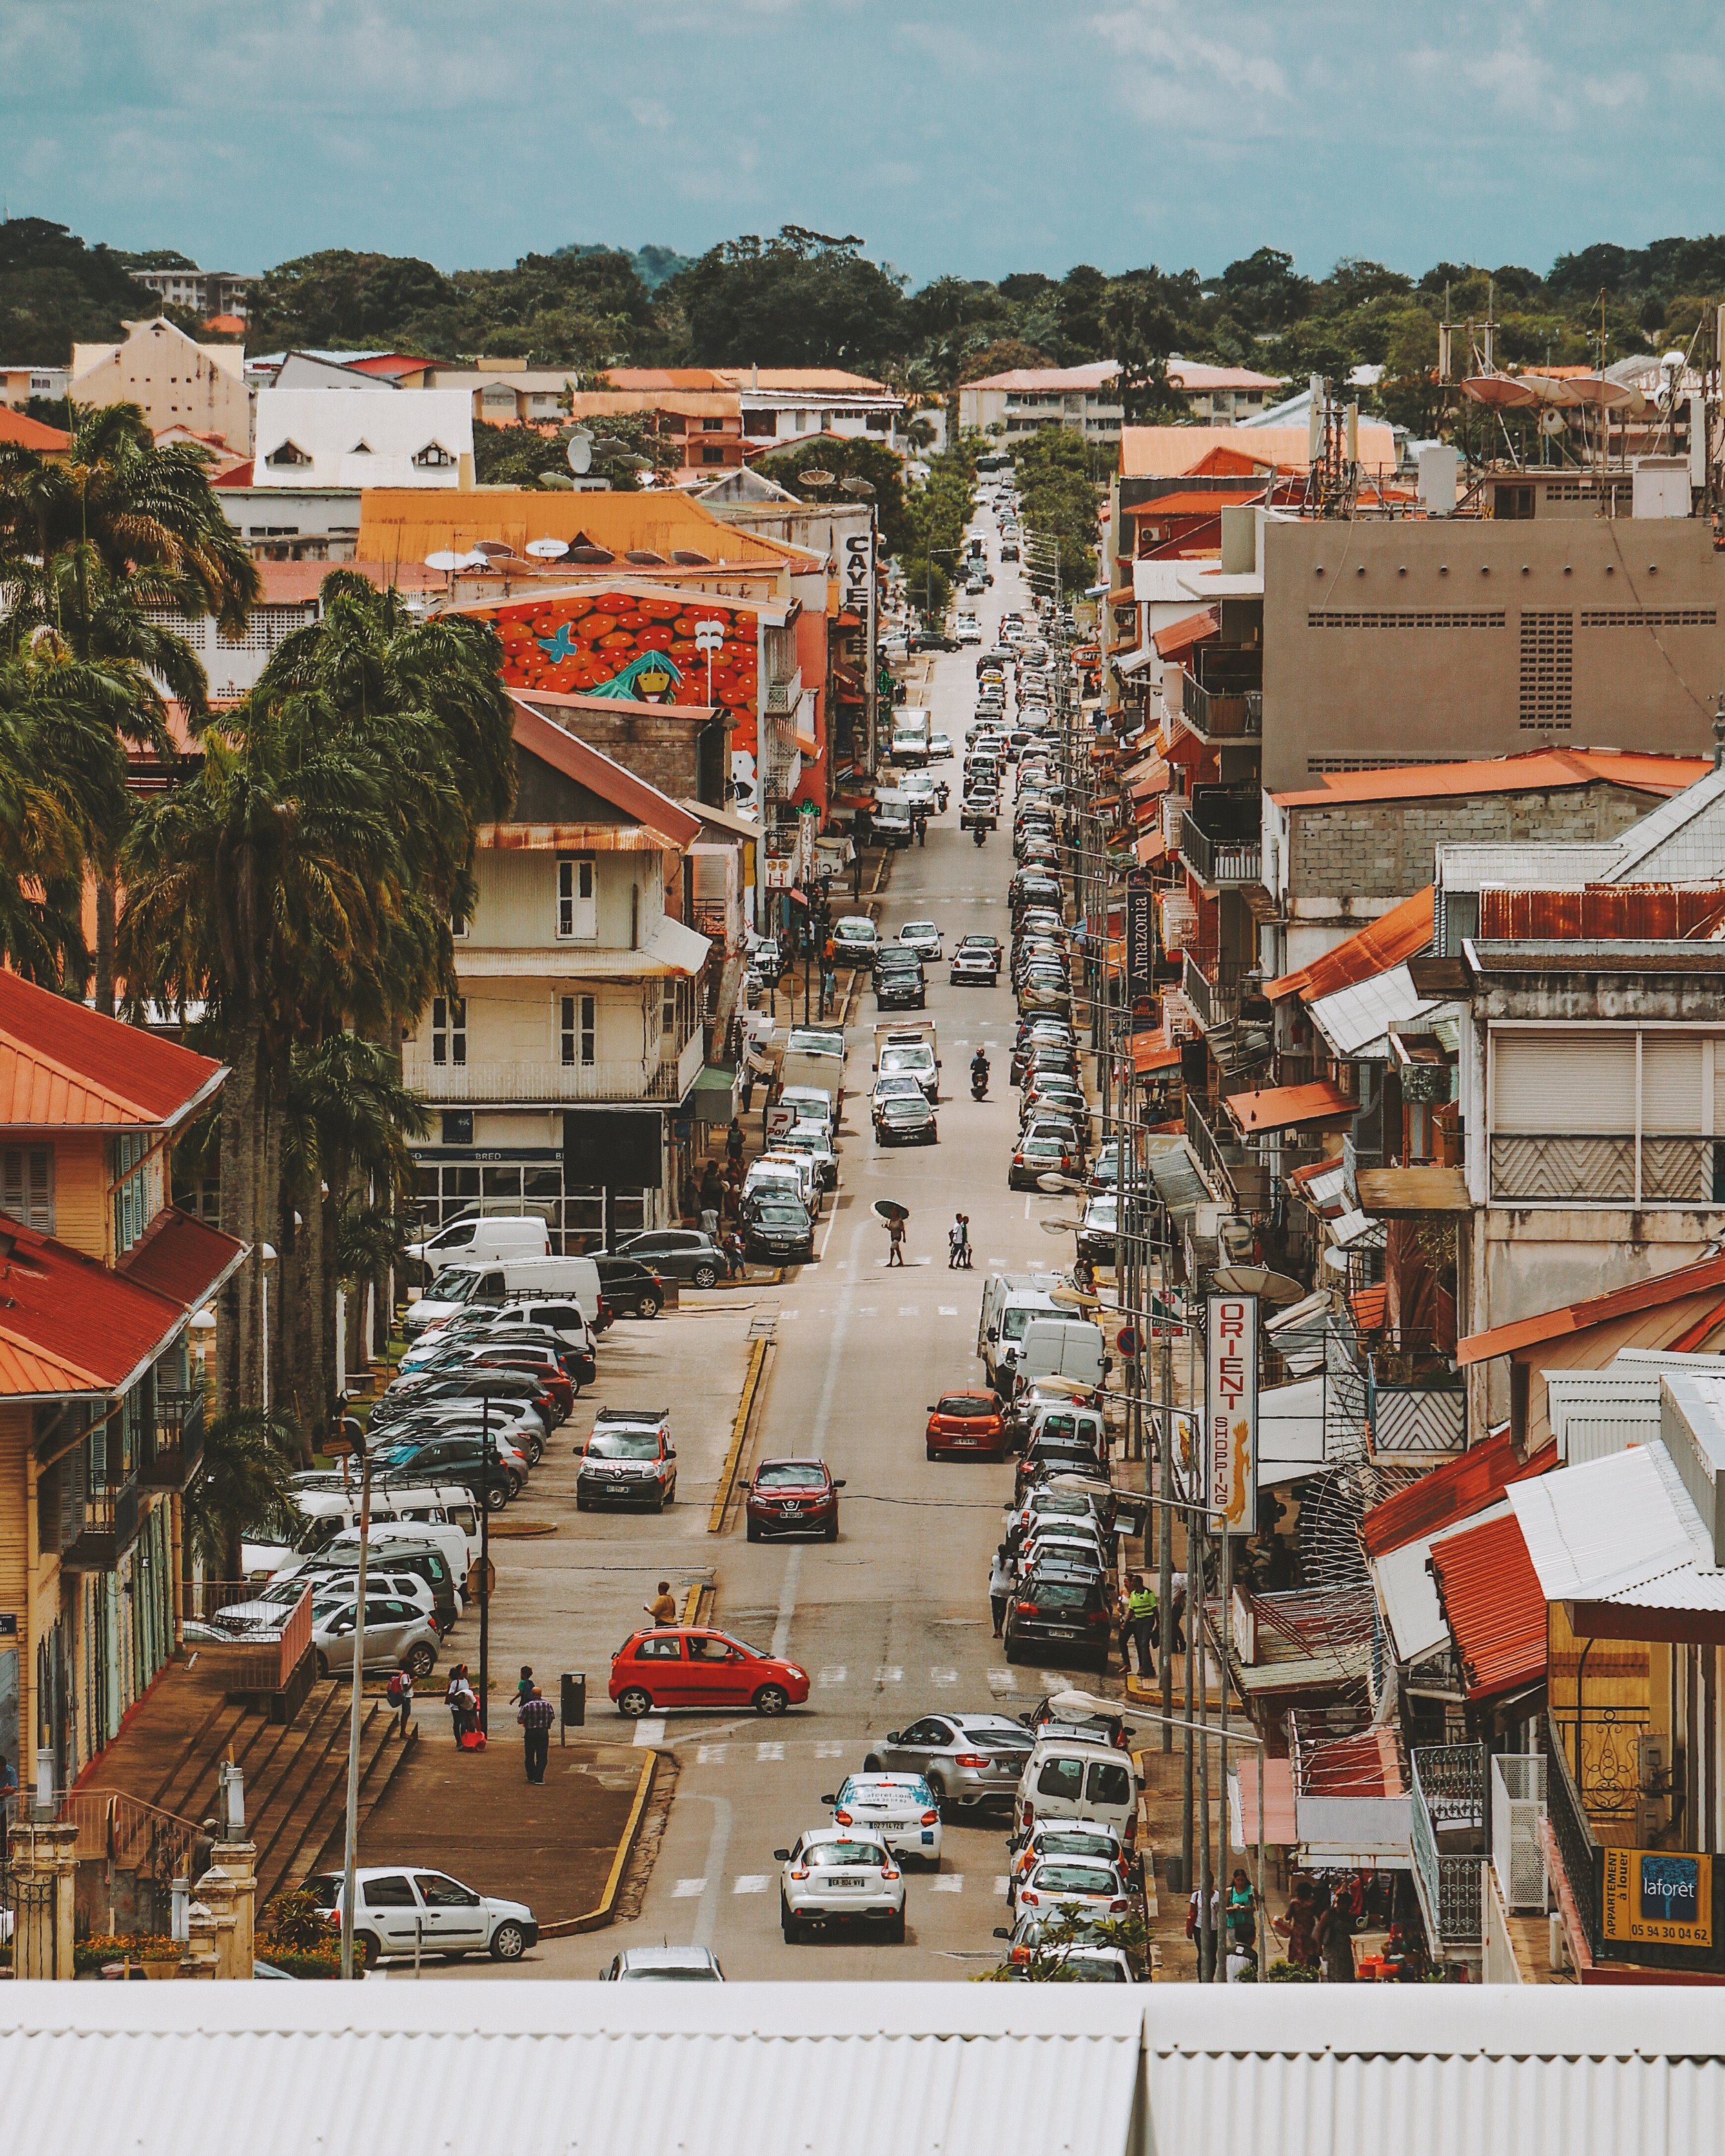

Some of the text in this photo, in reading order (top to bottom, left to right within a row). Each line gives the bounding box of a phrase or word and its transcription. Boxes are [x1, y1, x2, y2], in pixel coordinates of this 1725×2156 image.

[1132, 896, 1147, 981] Amazonia
[1220, 1303, 1244, 1410] ORIENT
[1214, 1416, 1228, 1505] SHOPPING
[1607, 1851, 1617, 1936] APPARTEMENT
[1617, 1852, 1628, 1888] louer
[1644, 1877, 1695, 1897] laforêt
[1631, 1924, 1708, 1940] 05 94 30 04 62
